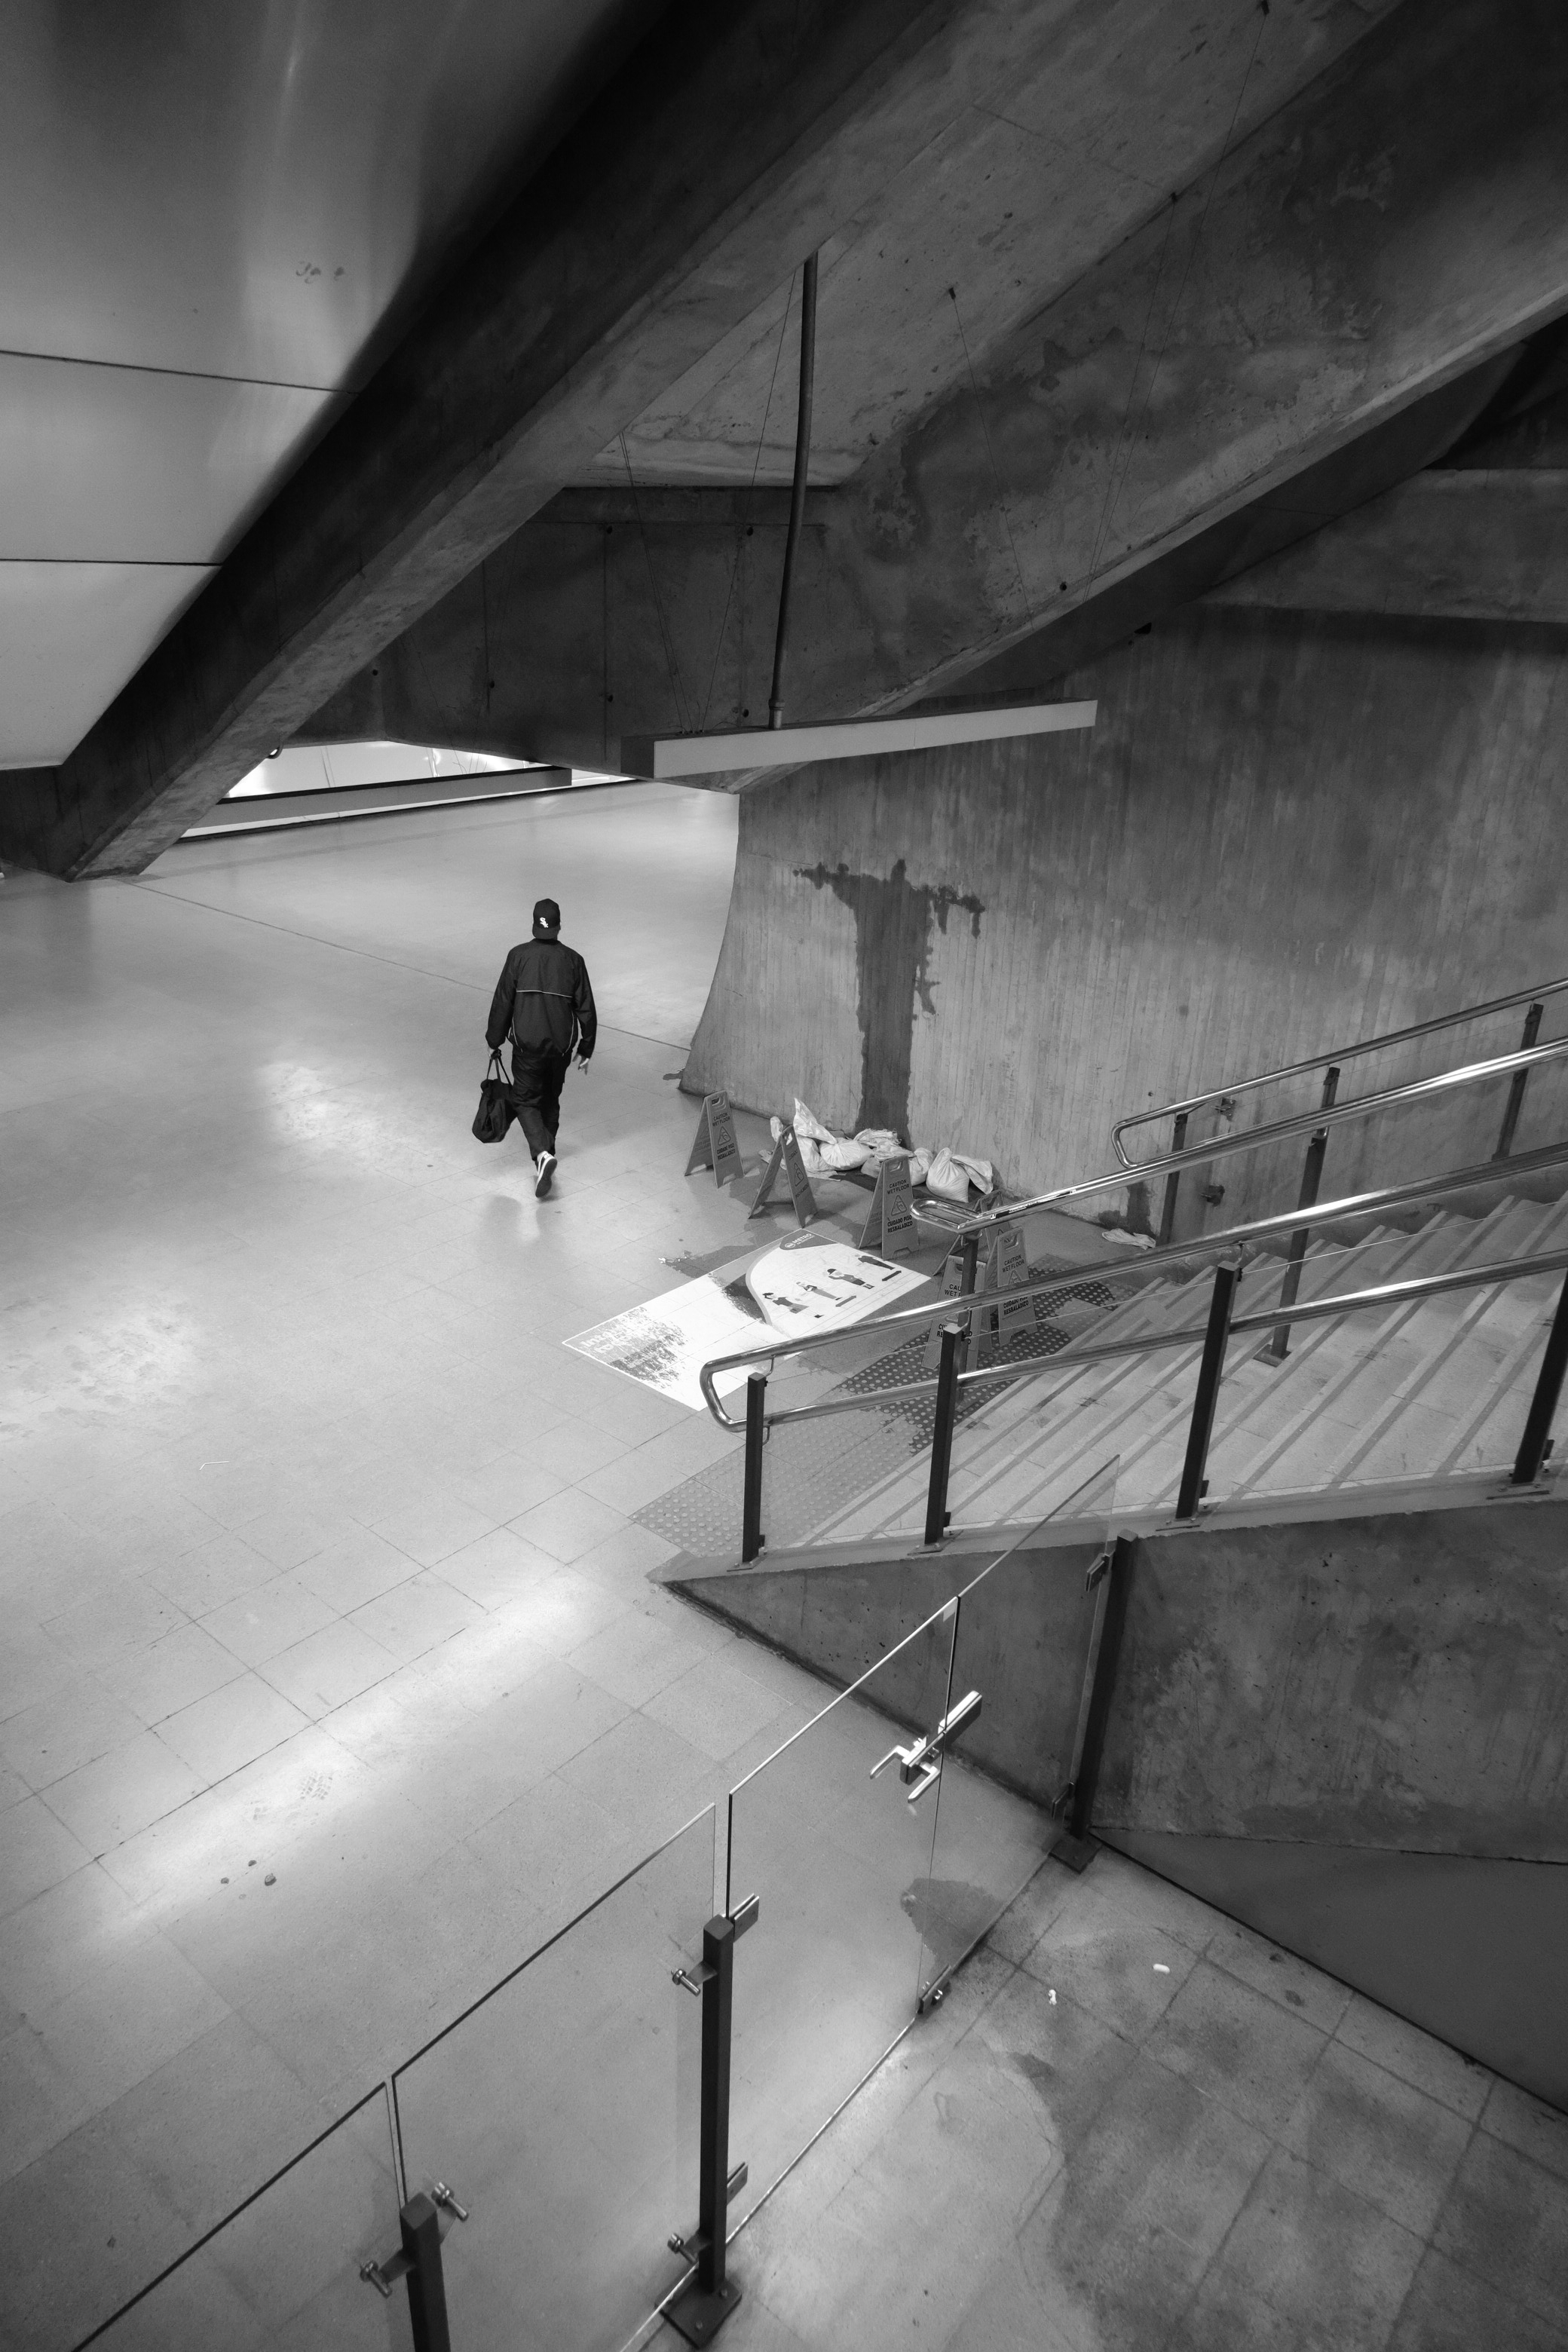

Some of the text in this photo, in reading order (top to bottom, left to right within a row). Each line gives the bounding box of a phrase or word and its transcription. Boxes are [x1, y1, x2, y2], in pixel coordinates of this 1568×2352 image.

[713, 1113, 728, 1121] CAUTION
[890, 1179, 907, 1188] CAUTION
[896, 1184, 910, 1192] FLOOR
[887, 1217, 902, 1227] CUIDADO
[887, 1220, 913, 1233] RESBALADIZO
[792, 1233, 812, 1244] METRO
[1002, 1259, 1025, 1272] WET FLOOR
[1004, 1254, 1021, 1266] CAUTION
[1003, 1300, 1029, 1315] RESBALADIZO
